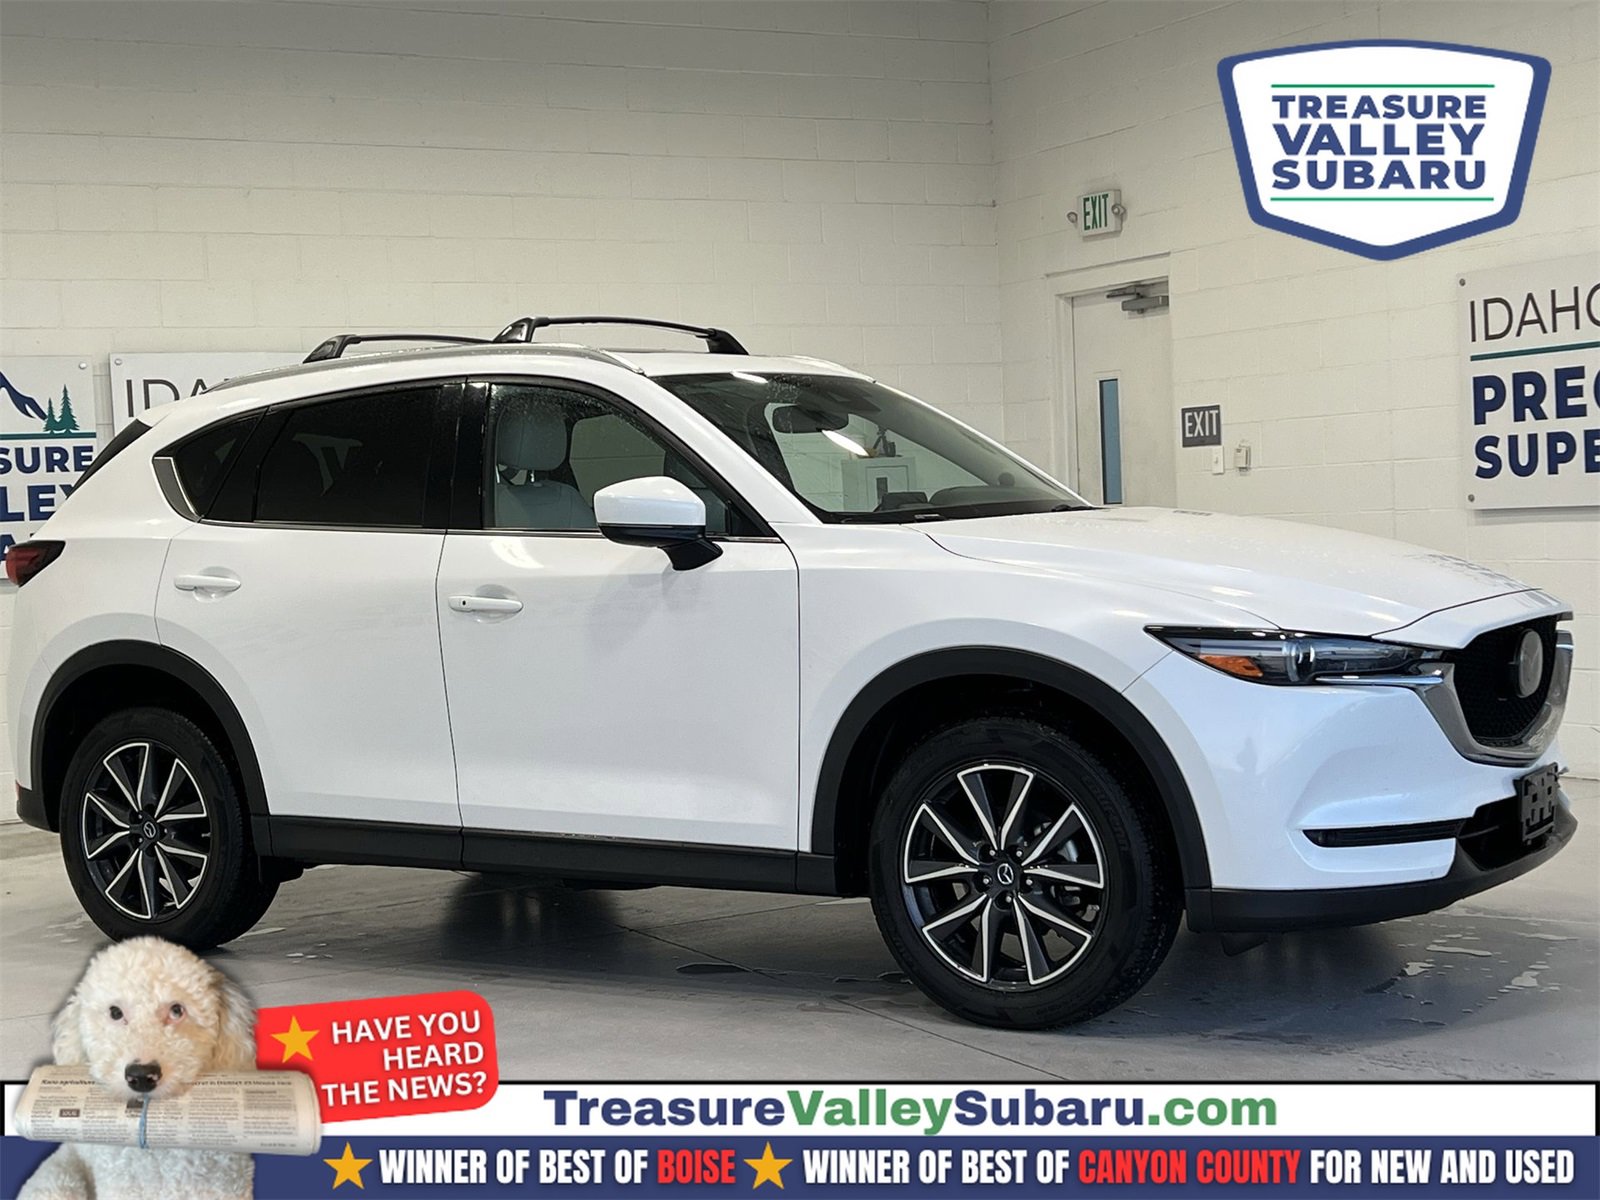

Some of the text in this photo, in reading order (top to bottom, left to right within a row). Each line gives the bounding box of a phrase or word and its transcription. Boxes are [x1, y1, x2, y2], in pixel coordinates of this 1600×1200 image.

[1083, 193, 1109, 231] EXIT
[1473, 365, 1600, 426] PRE
[1184, 409, 1219, 438] EXIT
